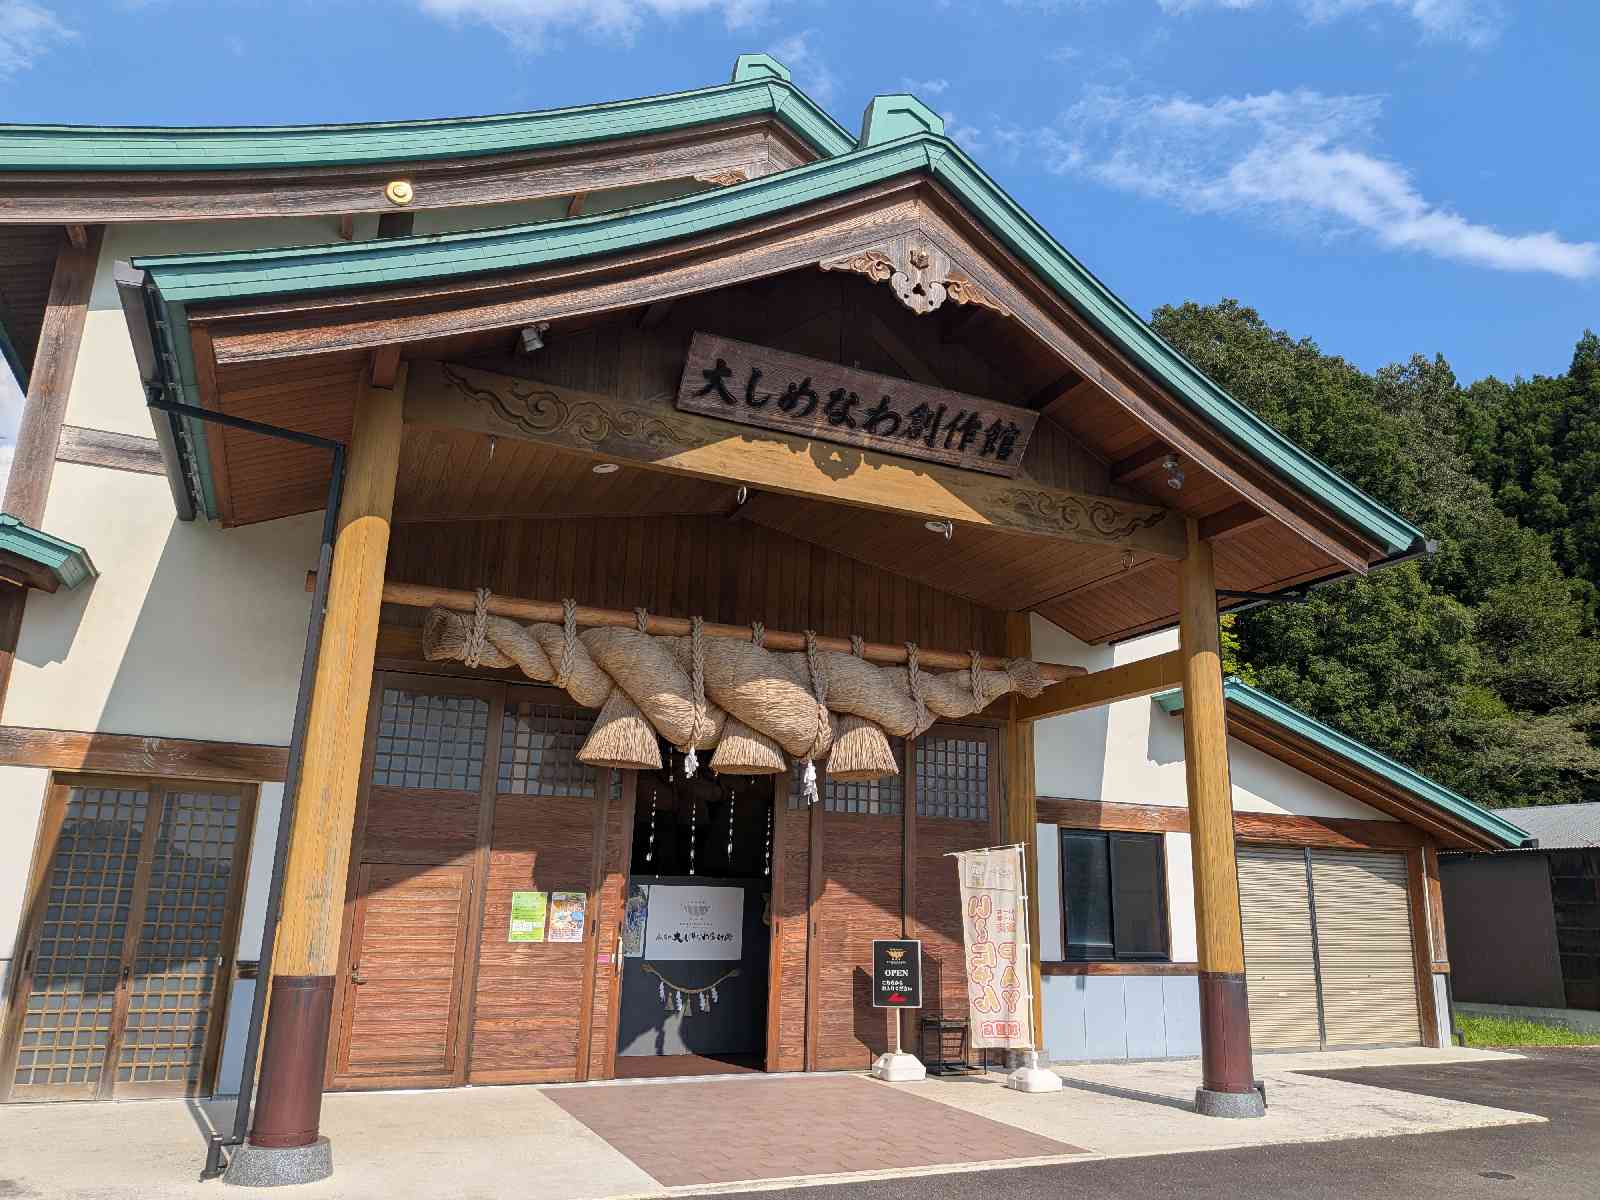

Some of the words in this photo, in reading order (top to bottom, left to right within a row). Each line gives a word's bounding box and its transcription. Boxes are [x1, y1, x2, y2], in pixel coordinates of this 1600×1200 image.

[692, 358, 1021, 461] 大しめなわ創作館
[884, 969, 909, 977] OPEN
